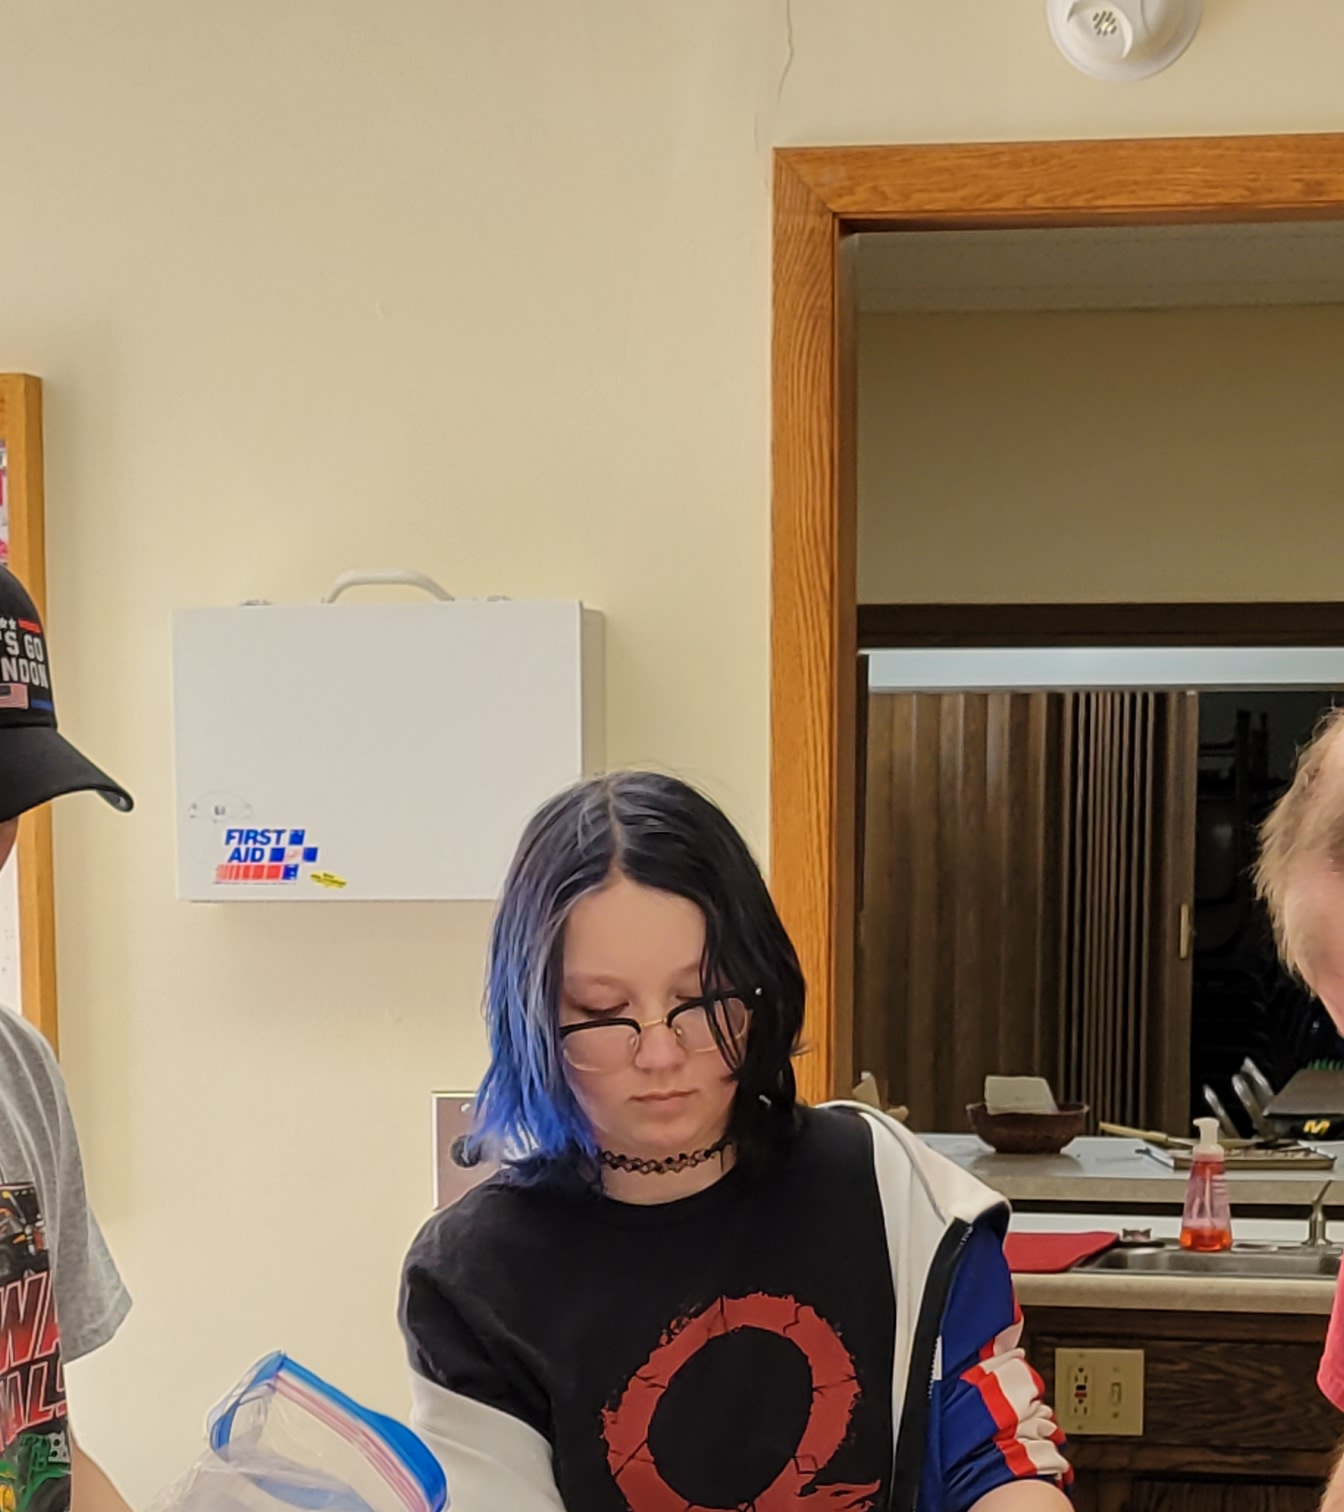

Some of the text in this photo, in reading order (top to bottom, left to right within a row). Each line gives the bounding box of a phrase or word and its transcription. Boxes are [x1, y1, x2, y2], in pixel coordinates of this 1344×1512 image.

[24, 637, 44, 662] GO
[225, 828, 286, 846] FIRST
[227, 847, 265, 863] AID
